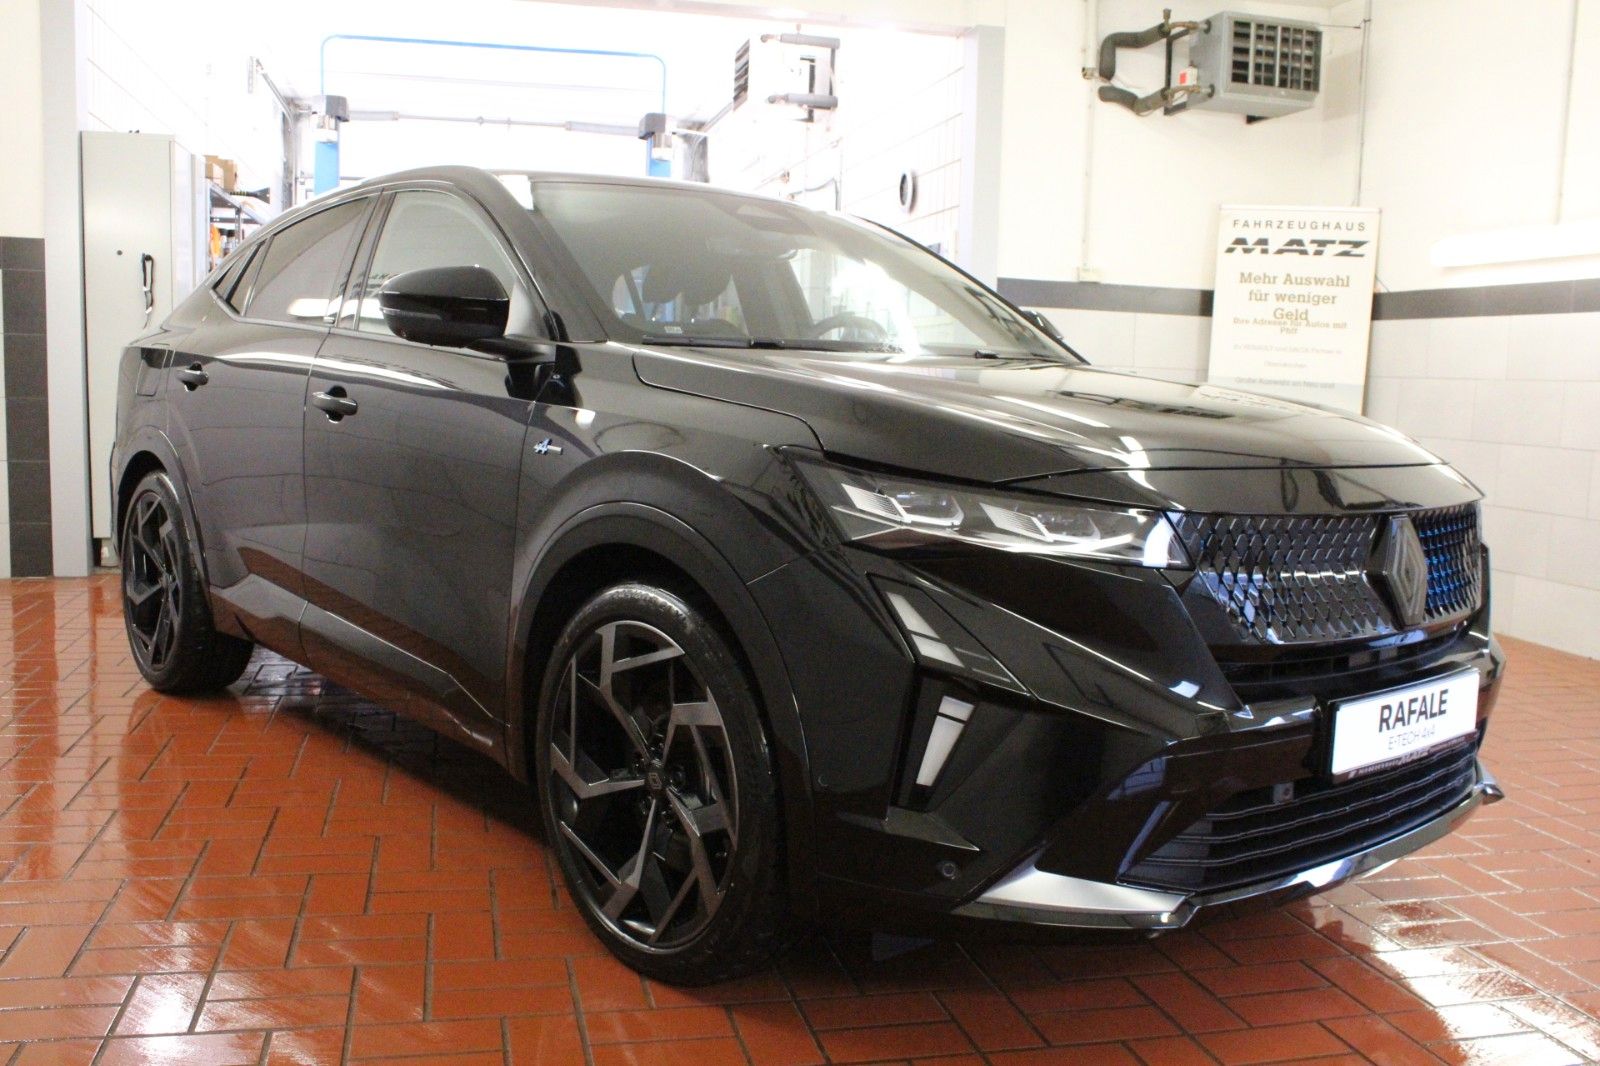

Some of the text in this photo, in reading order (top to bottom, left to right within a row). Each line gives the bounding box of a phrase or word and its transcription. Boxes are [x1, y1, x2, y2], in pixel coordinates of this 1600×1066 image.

[1233, 219, 1366, 231] FAHRZEUGHAUS
[1224, 237, 1370, 257] MATZ
[1239, 272, 1350, 287] Mehr Auswahl
[1248, 289, 1338, 306] für weniger
[1273, 307, 1309, 320] Geld
[1305, 320, 1330, 328] Autos
[1332, 321, 1347, 329] mit
[1378, 689, 1448, 732] RAFALE
